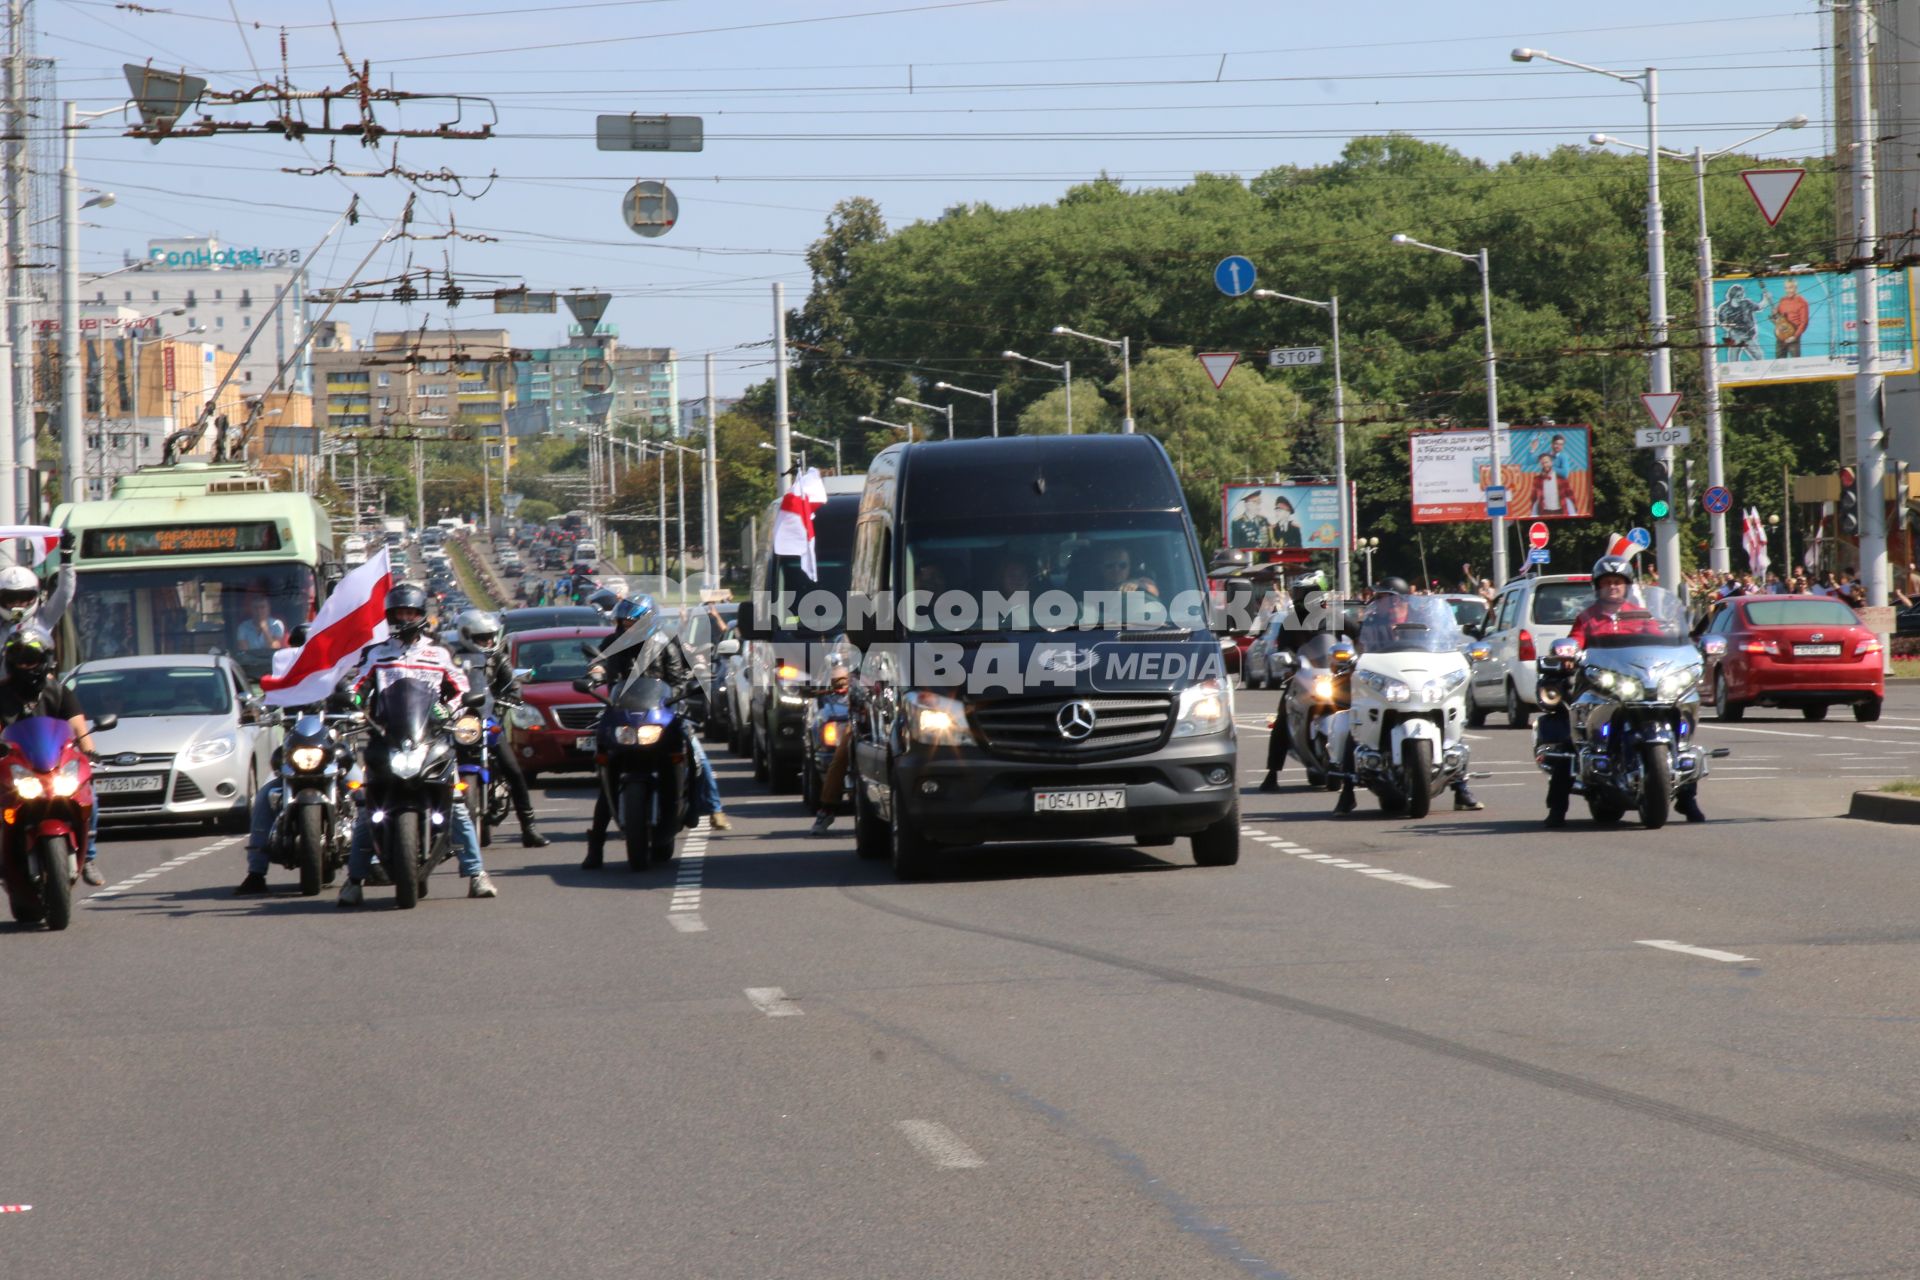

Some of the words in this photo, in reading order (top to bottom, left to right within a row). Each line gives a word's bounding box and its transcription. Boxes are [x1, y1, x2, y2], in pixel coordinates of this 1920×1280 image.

[1276, 350, 1317, 365] STOP
[1645, 430, 1682, 444] STOP
[107, 533, 127, 552] 44
